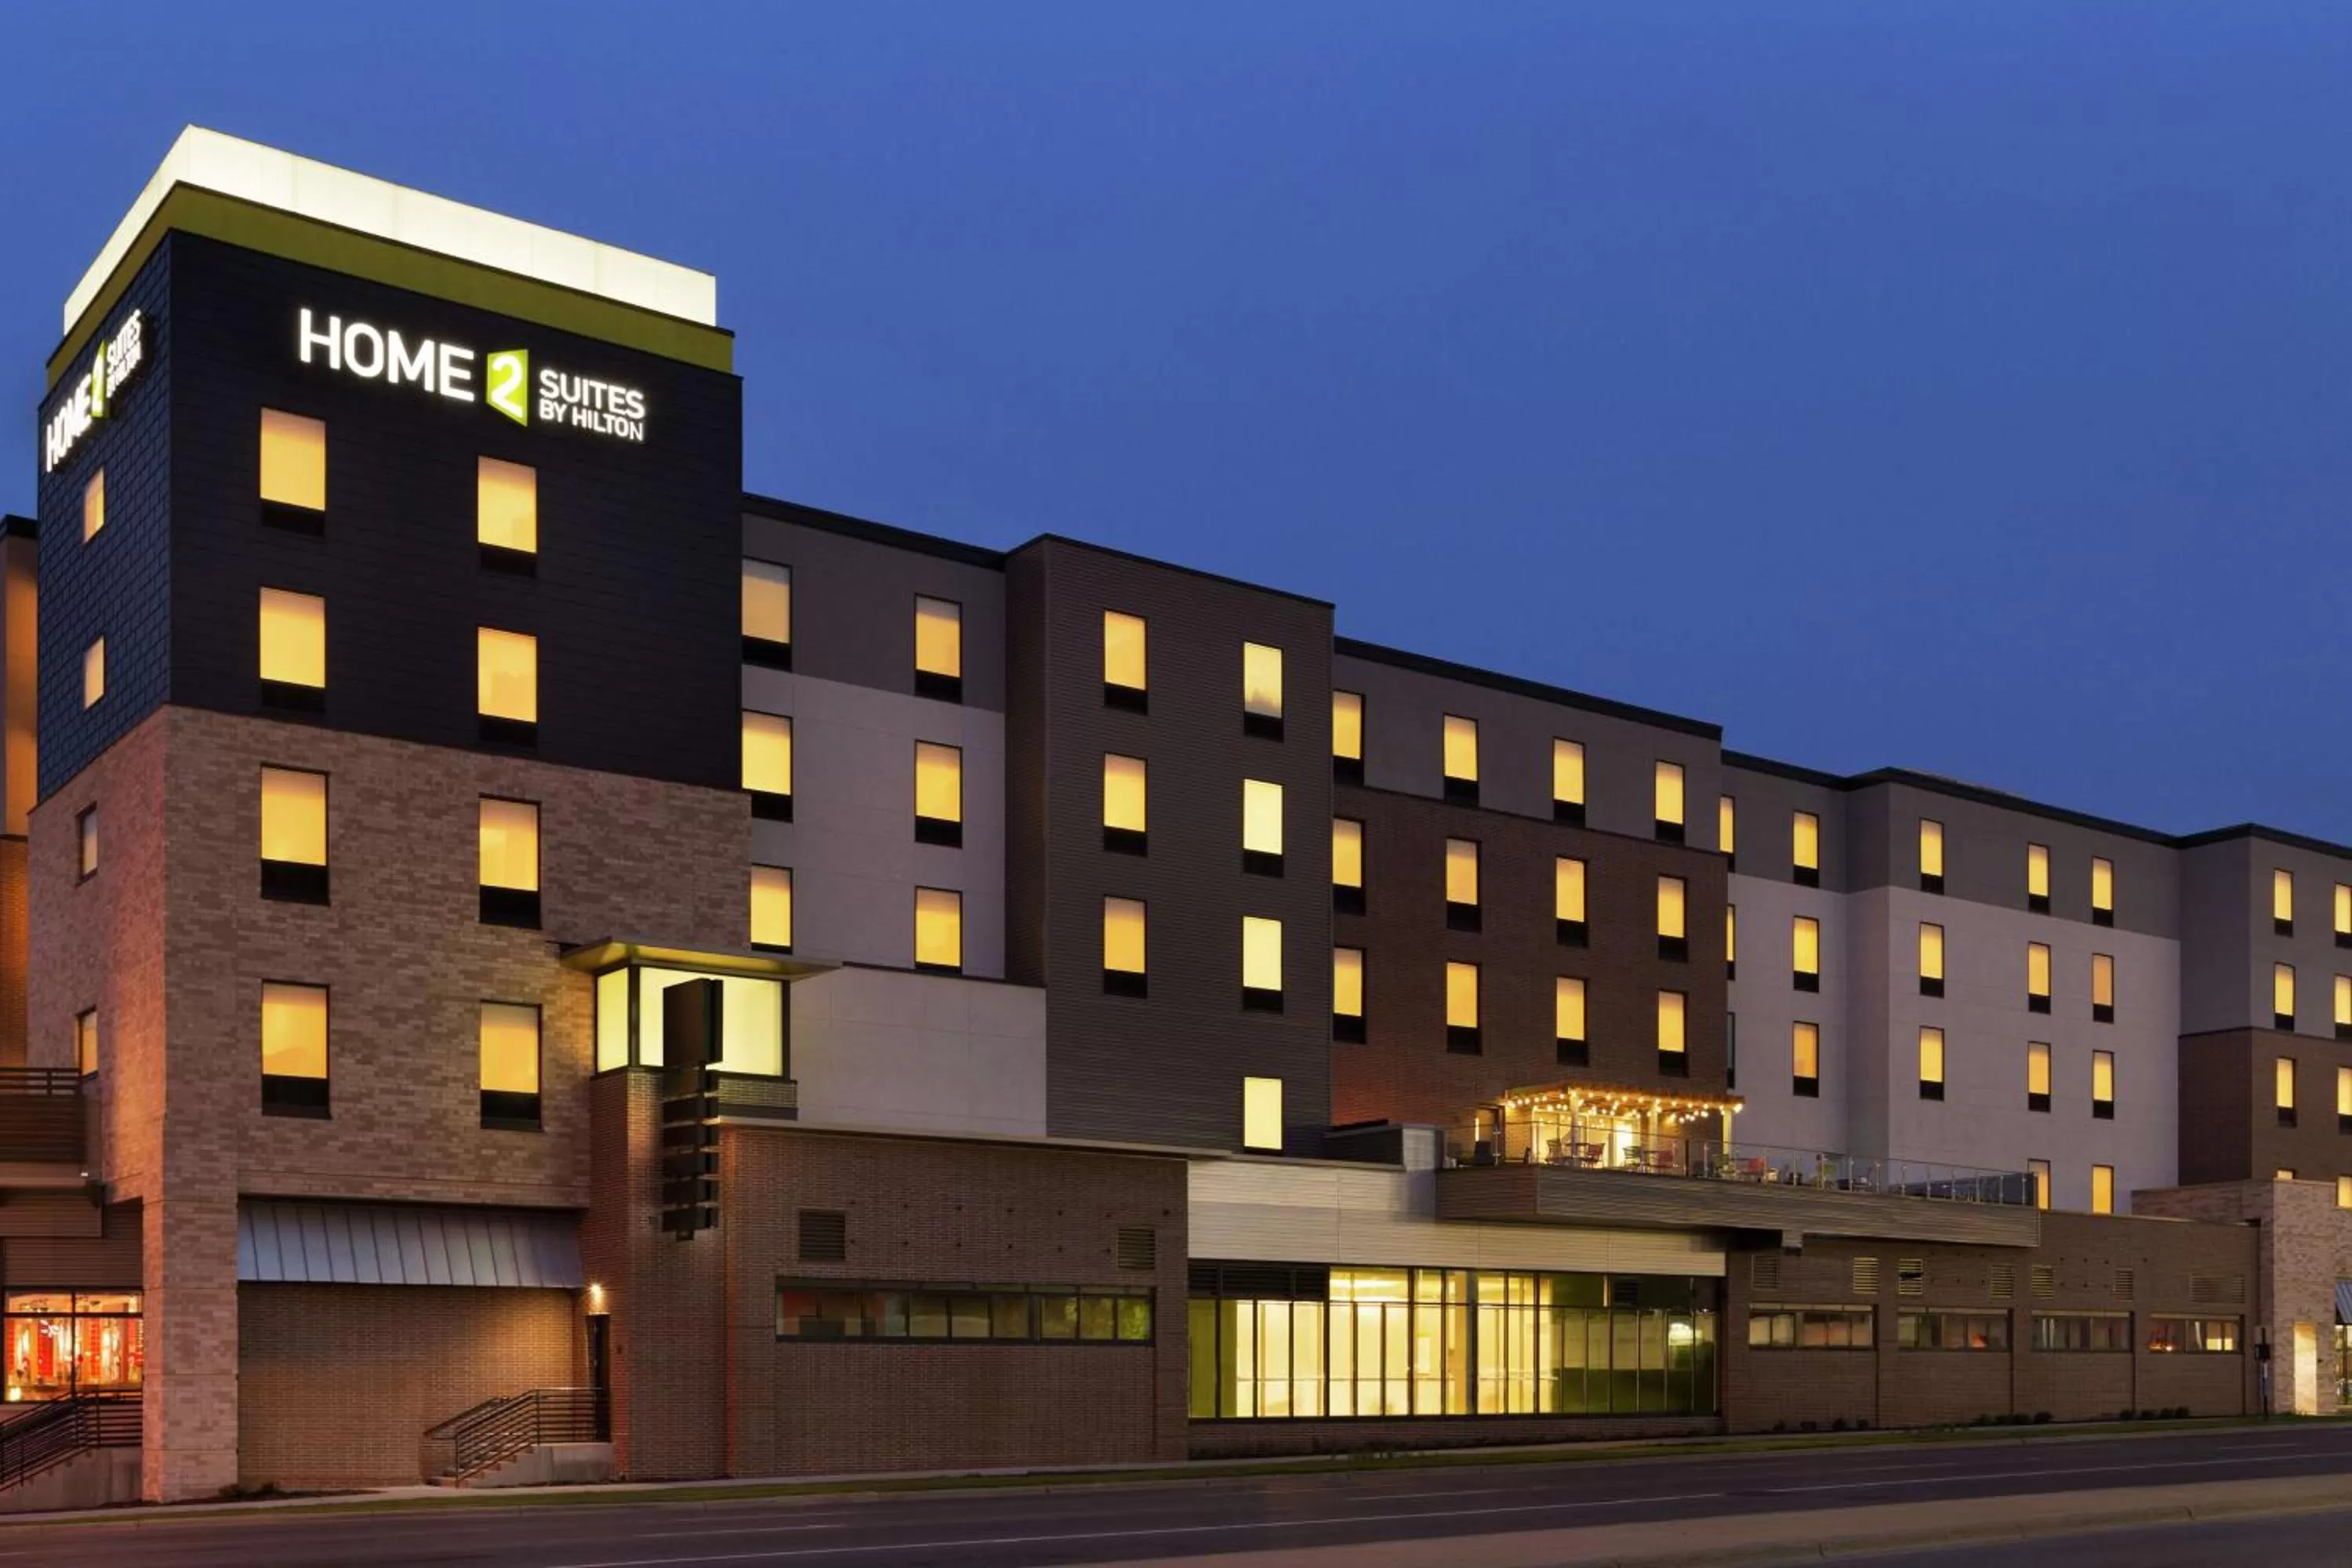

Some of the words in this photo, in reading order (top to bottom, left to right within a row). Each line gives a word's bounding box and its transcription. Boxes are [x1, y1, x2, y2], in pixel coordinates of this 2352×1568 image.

[299, 308, 475, 402] HOME
[492, 354, 524, 418] 2
[539, 369, 645, 419] SUITES
[47, 372, 92, 473] HOME
[539, 398, 567, 423] BY
[572, 405, 644, 441] HILTON
